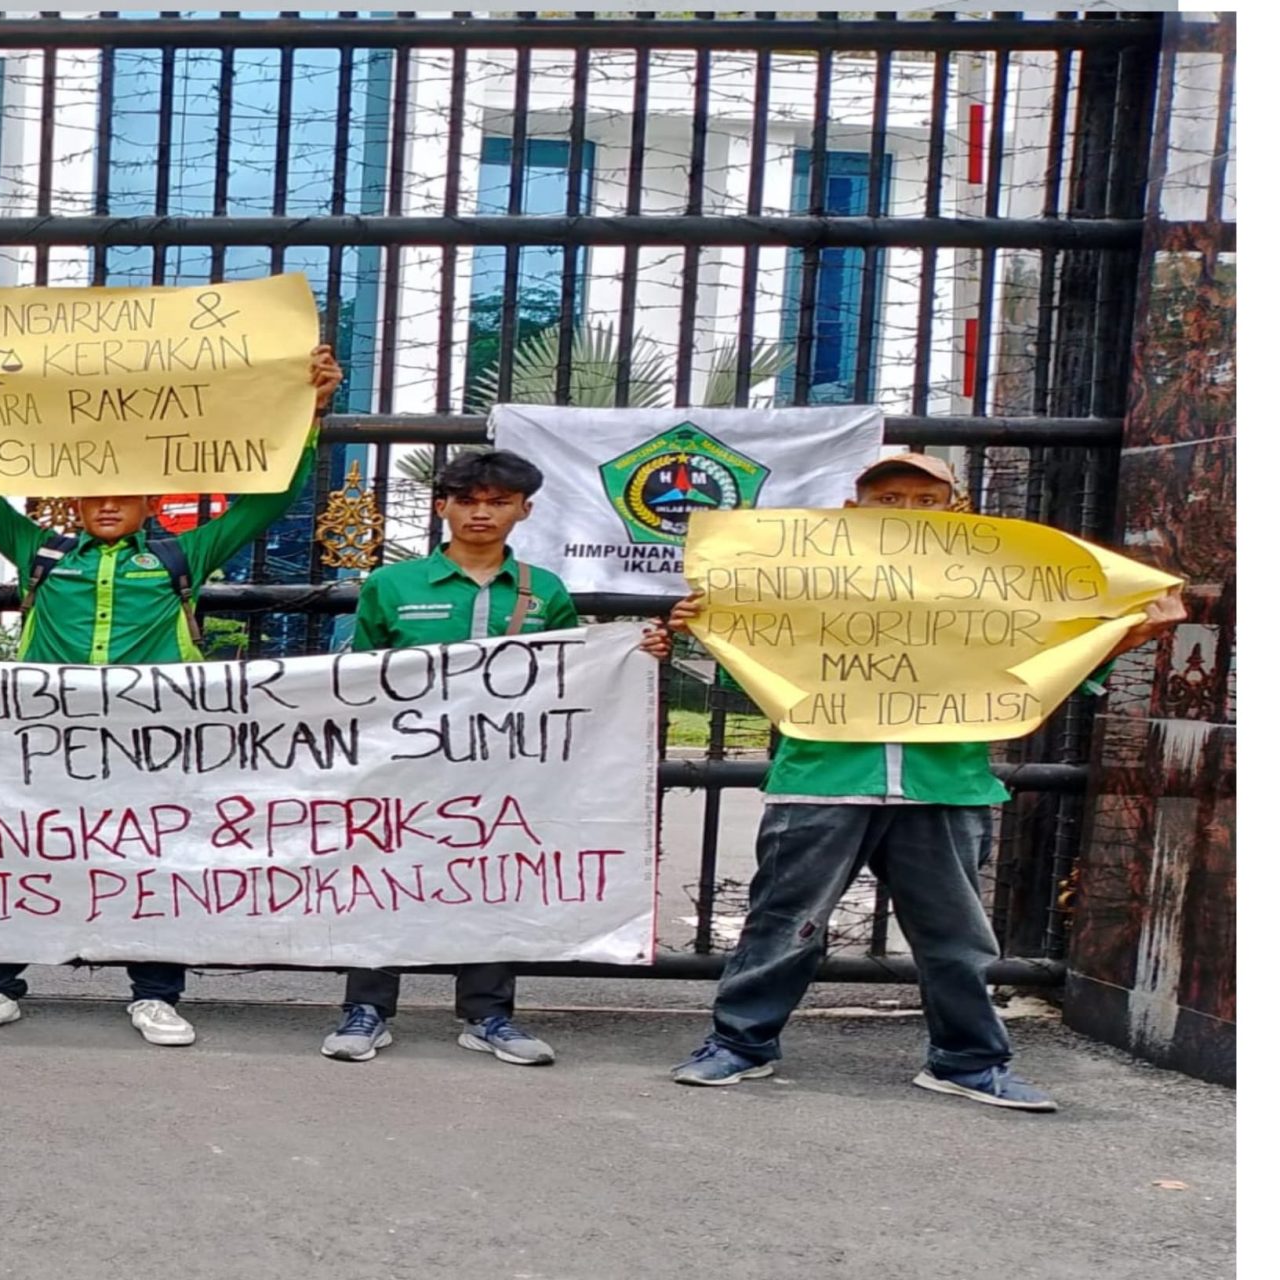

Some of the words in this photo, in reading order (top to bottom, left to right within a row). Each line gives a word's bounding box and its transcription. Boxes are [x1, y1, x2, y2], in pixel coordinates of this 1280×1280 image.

[189, 291, 241, 331] &
[42, 333, 253, 378] KERJAKAN
[68, 383, 211, 425] RAKYAT
[145, 432, 269, 477] TUHAN
[660, 471, 672, 484] H
[691, 471, 707, 485] M
[564, 543, 676, 559] HIMPUNAN
[736, 516, 854, 558] JIKA
[879, 516, 1001, 557] DINAS
[705, 565, 915, 605] PENDIDIKAN
[934, 564, 1100, 603] SARANG
[706, 609, 795, 648] PARA
[819, 608, 1046, 649] KORUPTOR
[331, 639, 586, 707] COPOT
[821, 652, 918, 683] MAKA
[14, 718, 359, 786] PENDIDIKAN
[391, 707, 592, 763] SUMUT
[210, 795, 255, 851] &
[266, 794, 542, 858] PERIKSA
[85, 864, 425, 924] PENDIDIKAN
[431, 849, 625, 907] SUMUT
